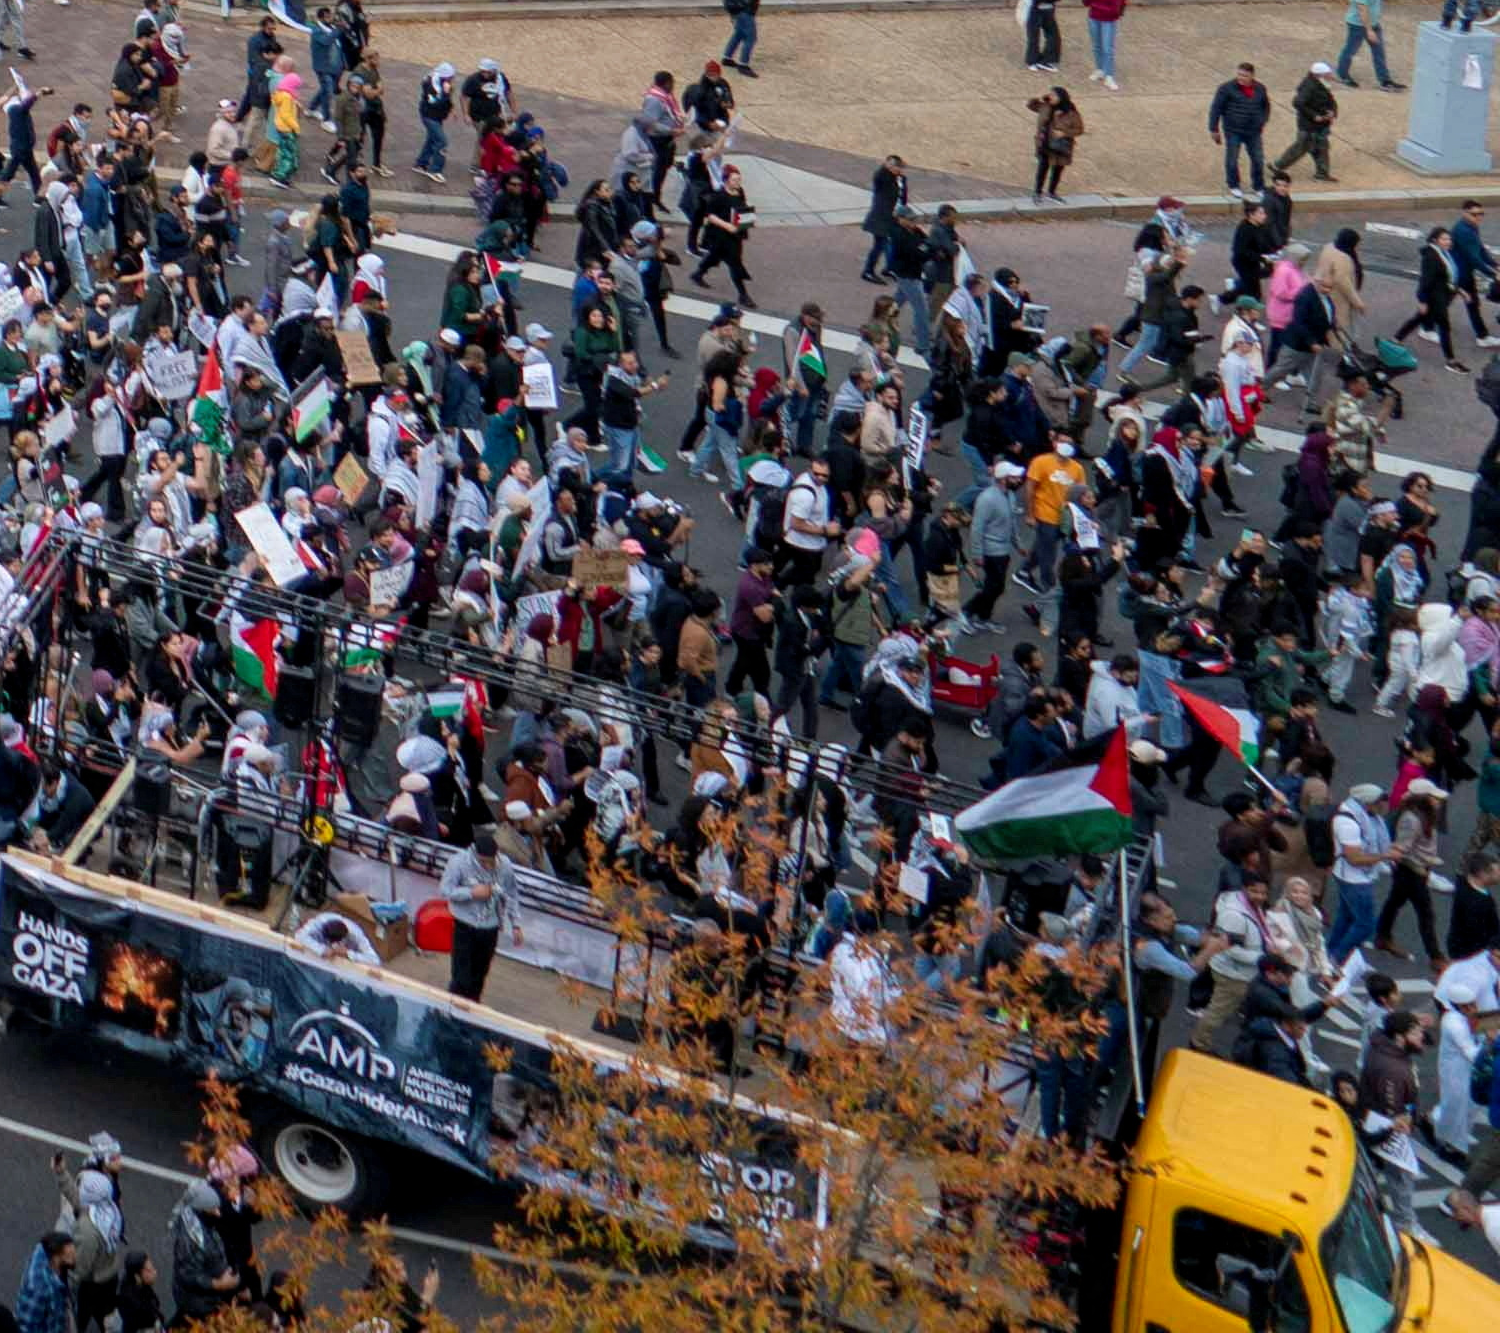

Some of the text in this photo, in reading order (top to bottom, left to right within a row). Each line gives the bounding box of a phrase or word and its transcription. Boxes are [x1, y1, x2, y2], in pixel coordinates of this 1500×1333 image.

[19, 910, 90, 954] HANDS
[12, 932, 89, 978] OFF
[12, 962, 85, 1006] GAZA
[296, 1026, 397, 1081] AMP
[403, 1084, 470, 1117] PALESTINE
[407, 1065, 473, 1098] AMERICAN
